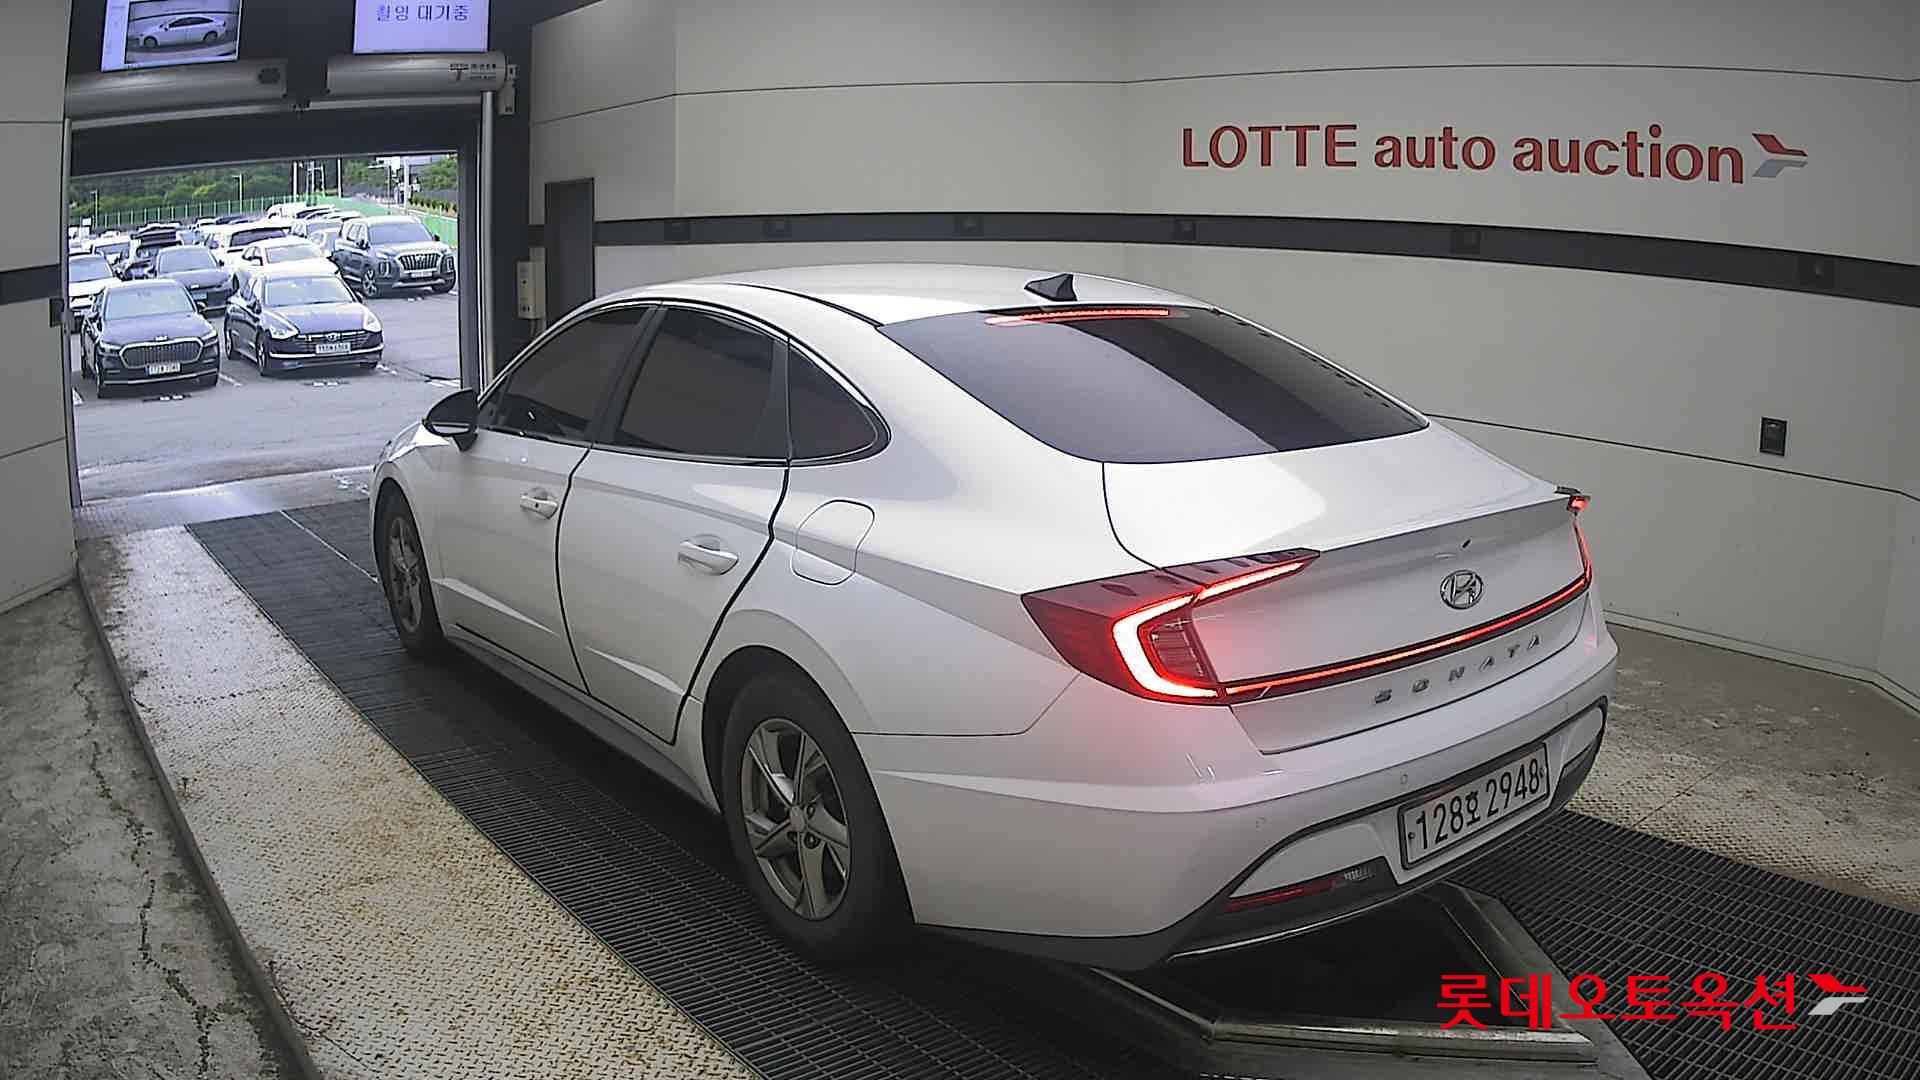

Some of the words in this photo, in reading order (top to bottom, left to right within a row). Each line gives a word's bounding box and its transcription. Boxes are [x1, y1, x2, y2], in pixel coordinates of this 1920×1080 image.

[417, 4, 468, 21] 대기중
[1183, 124, 1358, 168] LOTTE
[1374, 127, 1495, 170] auto
[1513, 125, 1744, 184] auction
[1374, 634, 1540, 704] SONATA
